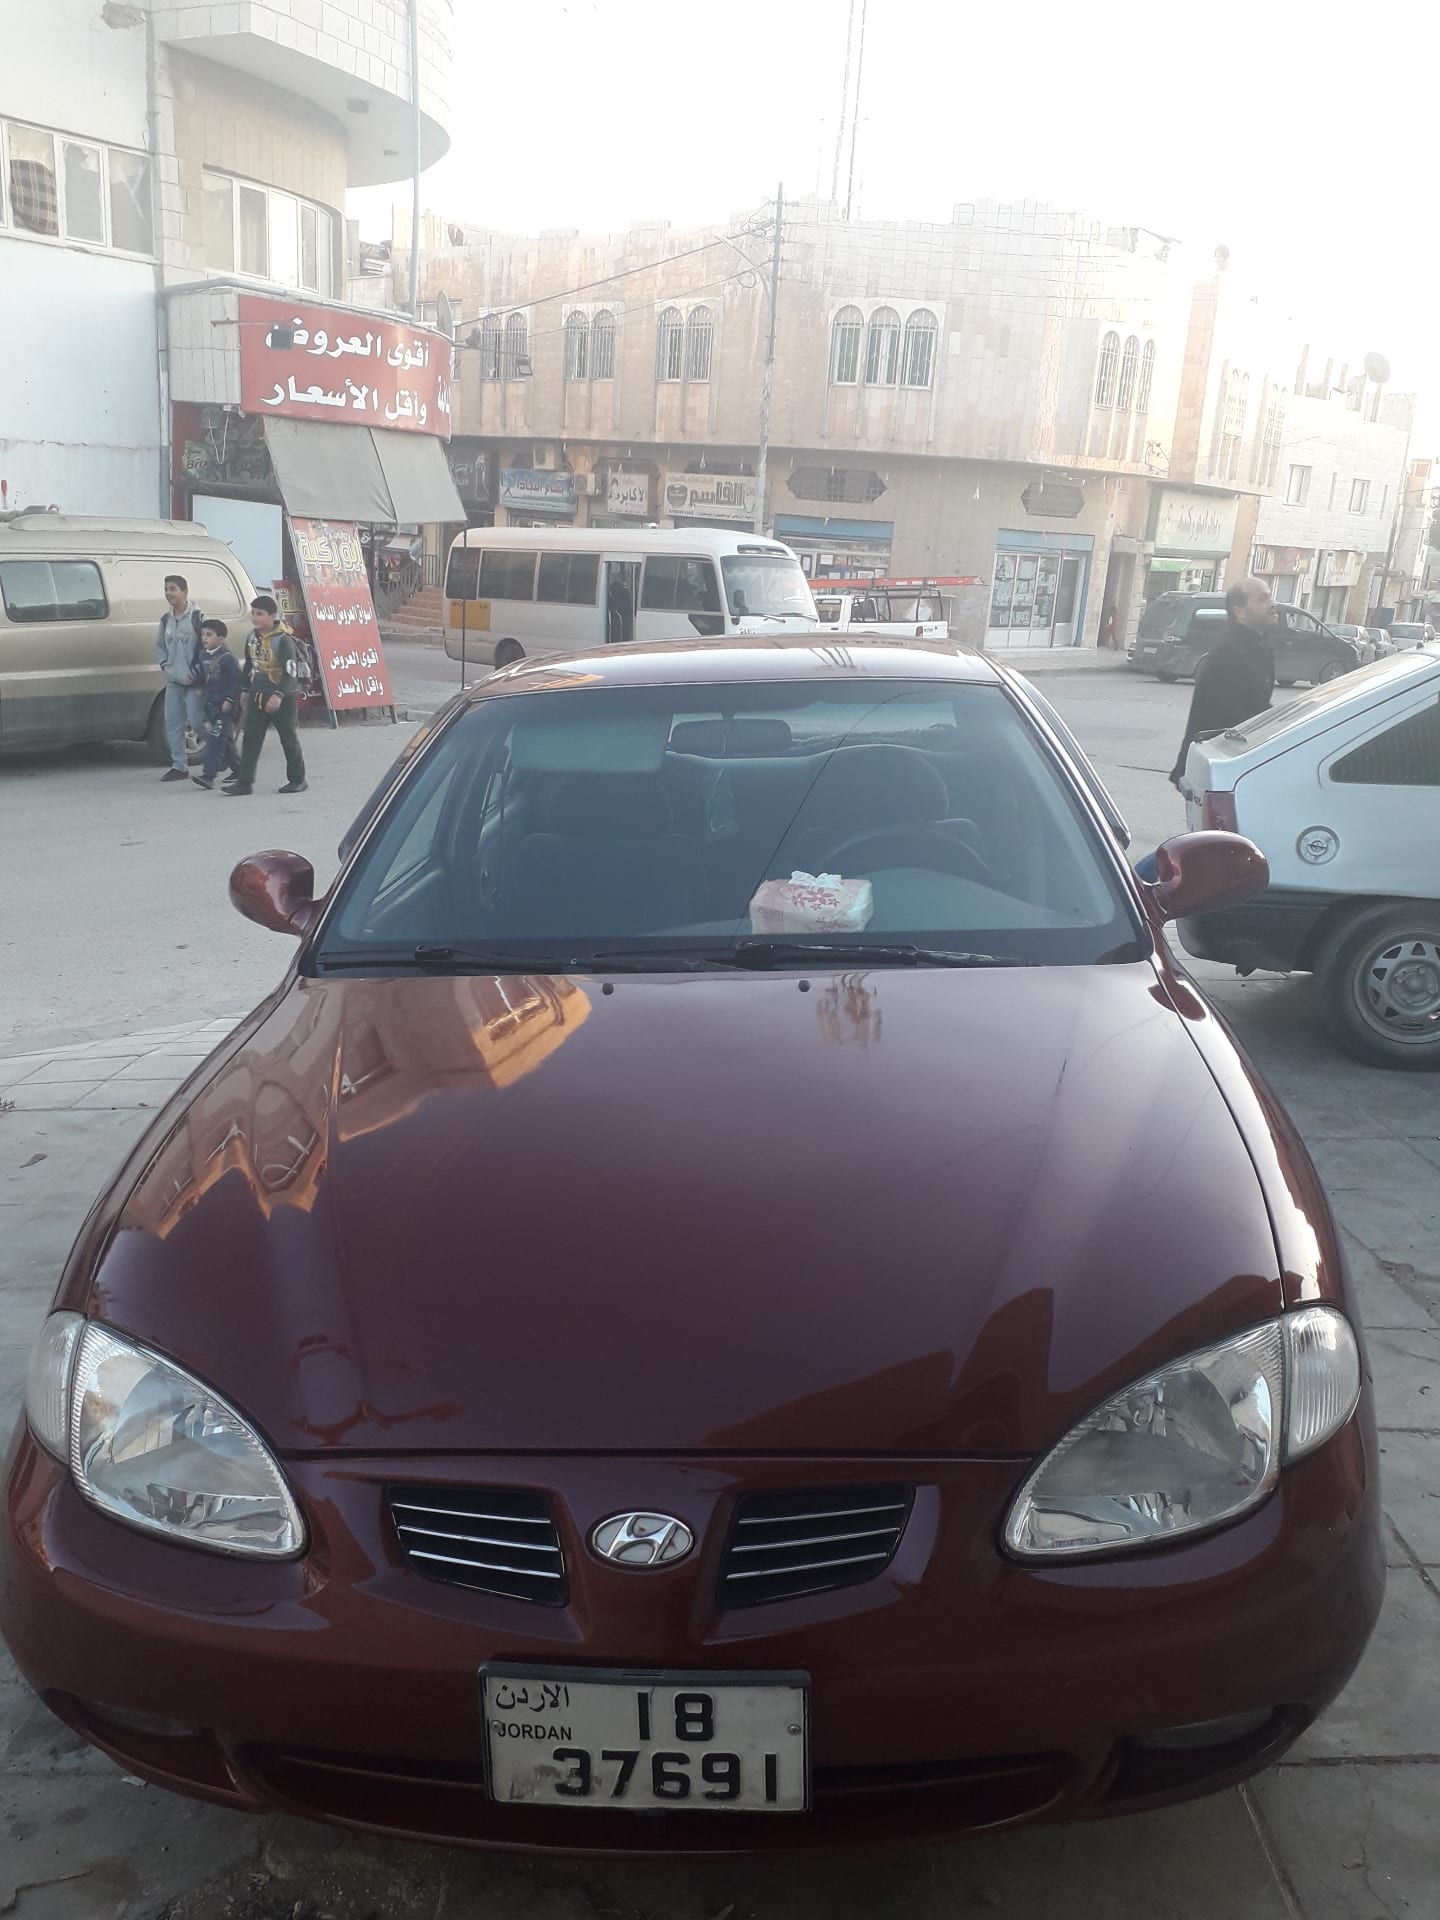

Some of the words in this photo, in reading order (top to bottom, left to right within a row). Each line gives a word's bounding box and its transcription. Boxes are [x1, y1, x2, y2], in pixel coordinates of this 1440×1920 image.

[387, 340, 430, 370] أقوى
[260, 375, 379, 411] الأسعار
[384, 389, 428, 425] وأقل
[330, 650, 360, 670] العروض
[360, 647, 379, 669] أقوى
[336, 676, 363, 698] الأسعار
[365, 675, 385, 697] وأقل
[495, 1683, 571, 1713] الاردن
[497, 1722, 573, 1741] JORDAN
[552, 1746, 778, 1804] 37691
